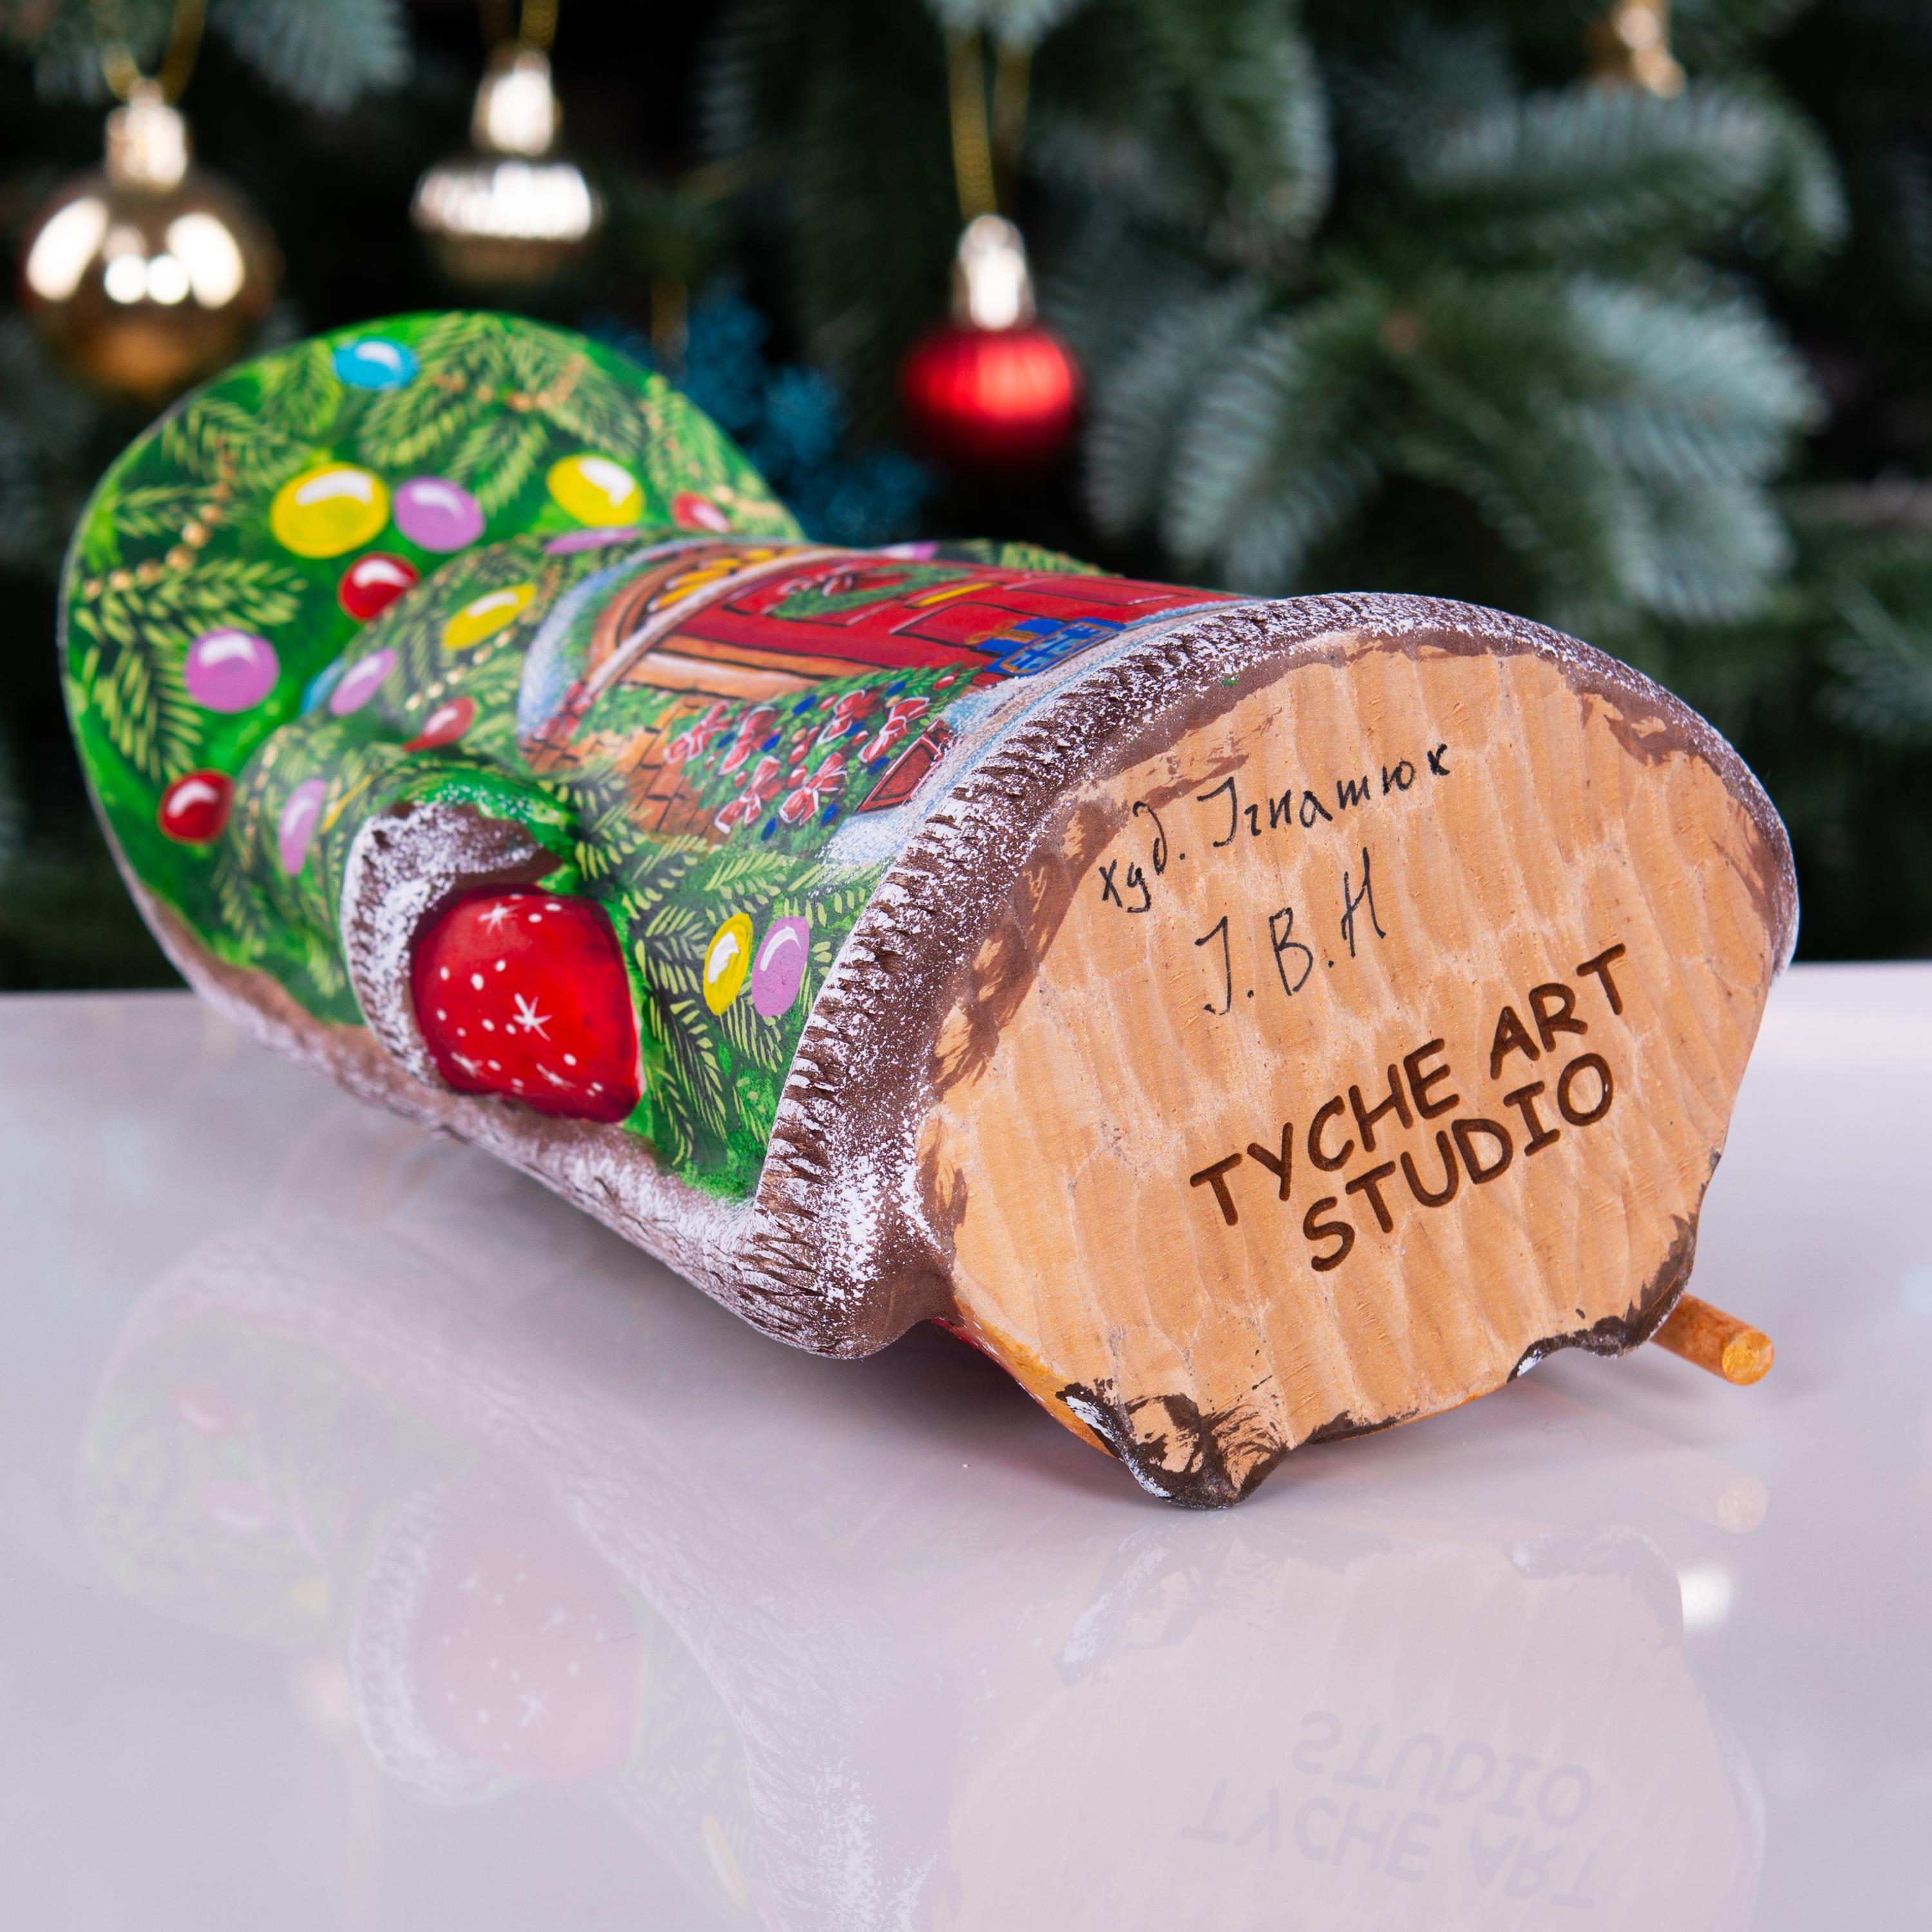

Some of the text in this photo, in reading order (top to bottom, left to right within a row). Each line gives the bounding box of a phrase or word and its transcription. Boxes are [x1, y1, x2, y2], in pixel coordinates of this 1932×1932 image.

[1189, 943, 1627, 1226] TYCHE ART
[1302, 1052, 1614, 1272] STUDIO
